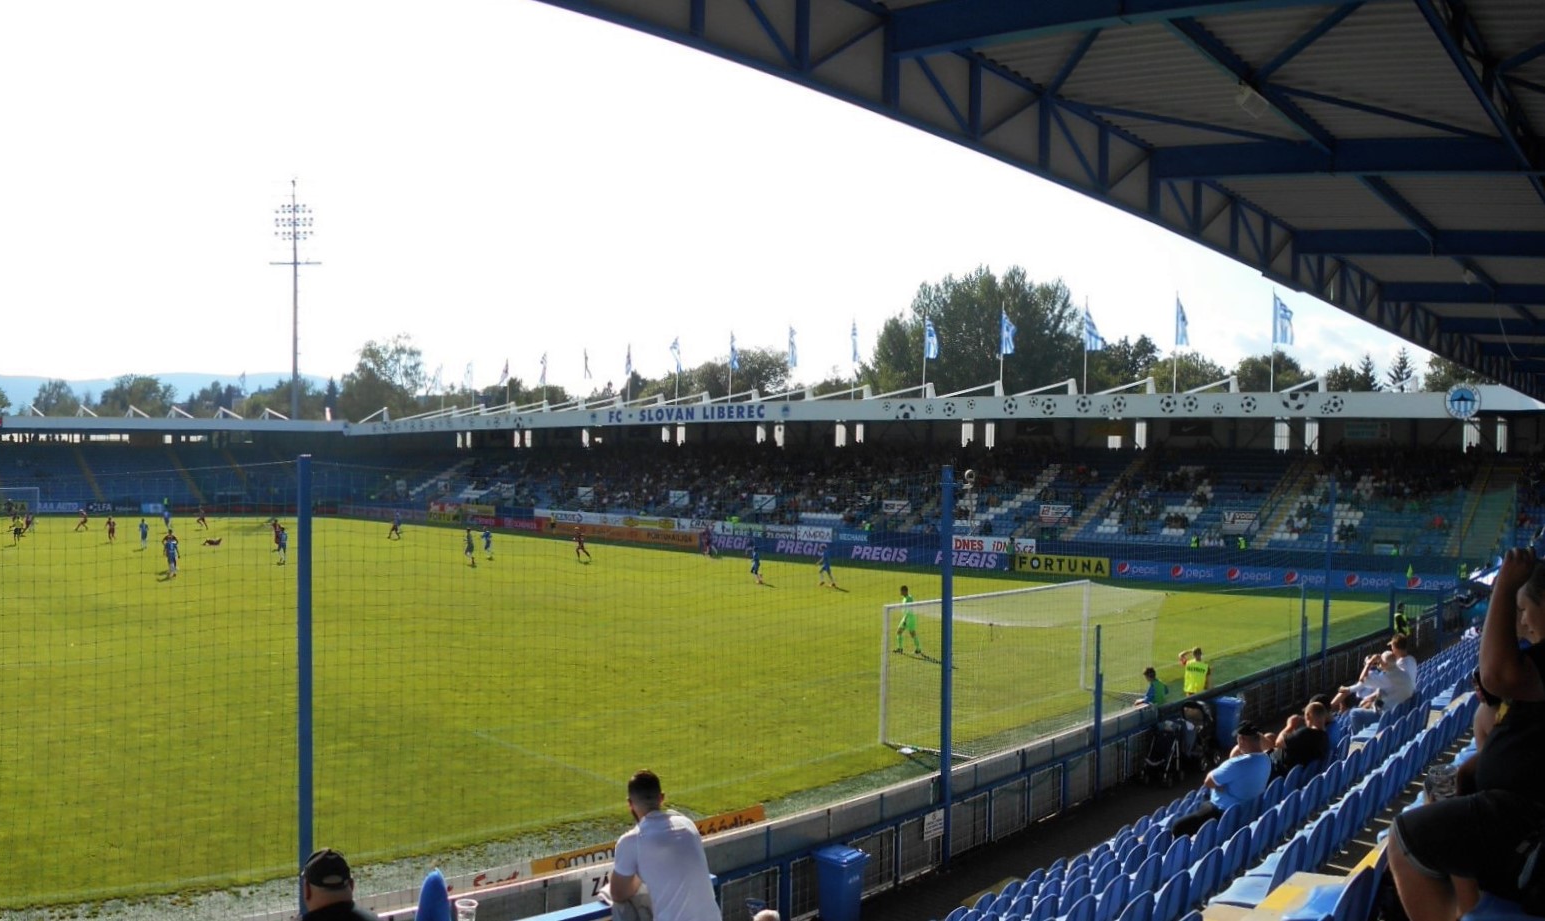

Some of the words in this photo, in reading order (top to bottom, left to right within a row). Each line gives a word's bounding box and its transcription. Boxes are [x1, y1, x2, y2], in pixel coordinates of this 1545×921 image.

[608, 411, 622, 423] FC
[639, 407, 695, 422] SLOVAN
[703, 404, 765, 419] LIBEREC
[711, 534, 750, 549] PREGI
[992, 538, 1034, 553] iDNS.cz
[851, 545, 909, 563] PREGIS
[1018, 556, 1106, 574] FORTUNA
[1132, 564, 1159, 576] pepsi
[1185, 567, 1214, 579] pepsi
[1242, 570, 1271, 582] pepsi
[1300, 573, 1326, 585] peps
